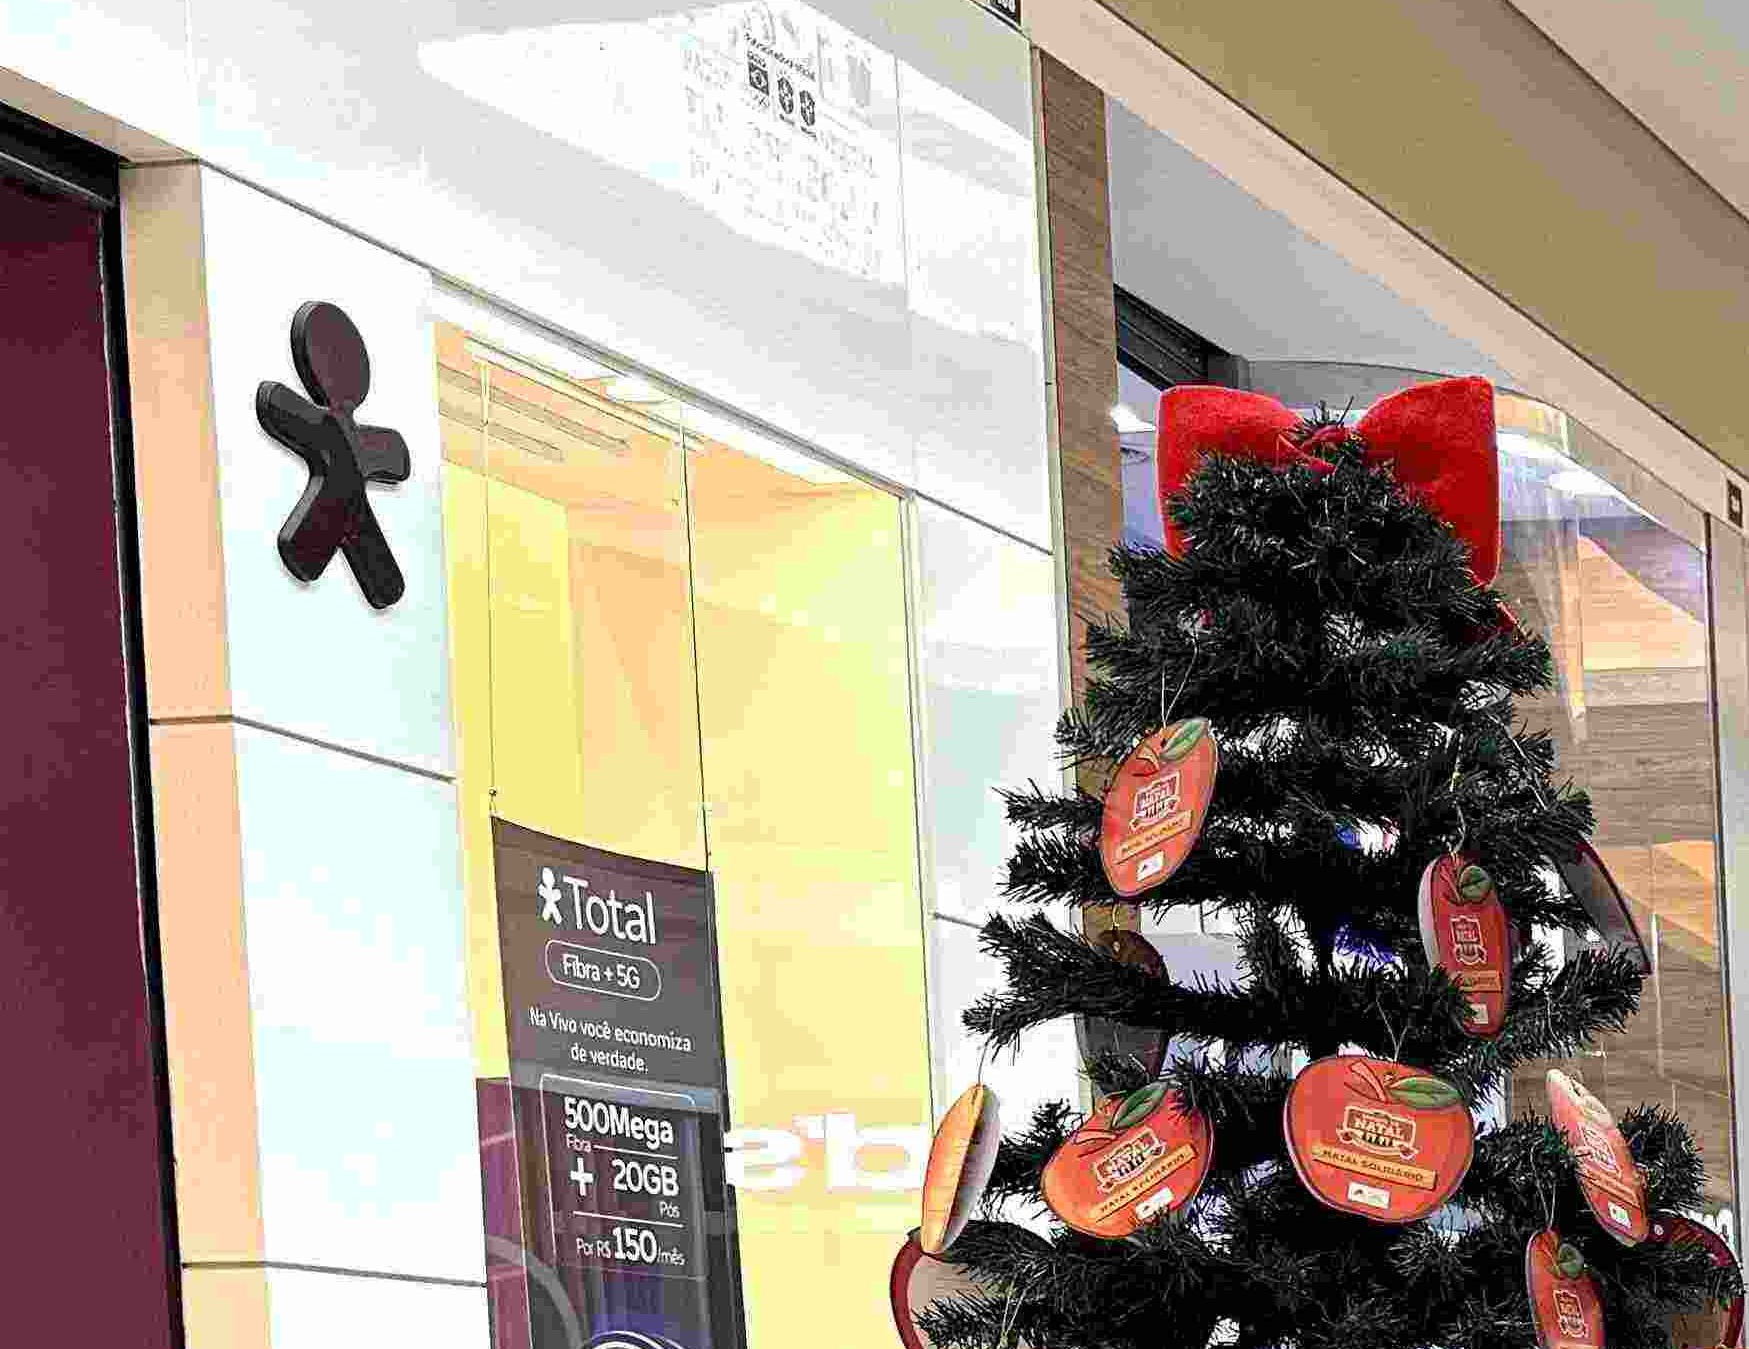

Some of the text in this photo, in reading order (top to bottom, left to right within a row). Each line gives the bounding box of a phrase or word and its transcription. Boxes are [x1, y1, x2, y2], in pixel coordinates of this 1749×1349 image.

[564, 875, 657, 945] Total
[562, 953, 602, 982] Fibra
[616, 962, 641, 989] 5G
[529, 1006, 693, 1052] Na Vivo você economiza
[570, 1041, 650, 1074] de verdade.
[564, 1096, 675, 1151] 500Mega
[611, 1158, 680, 1197] 20GB
